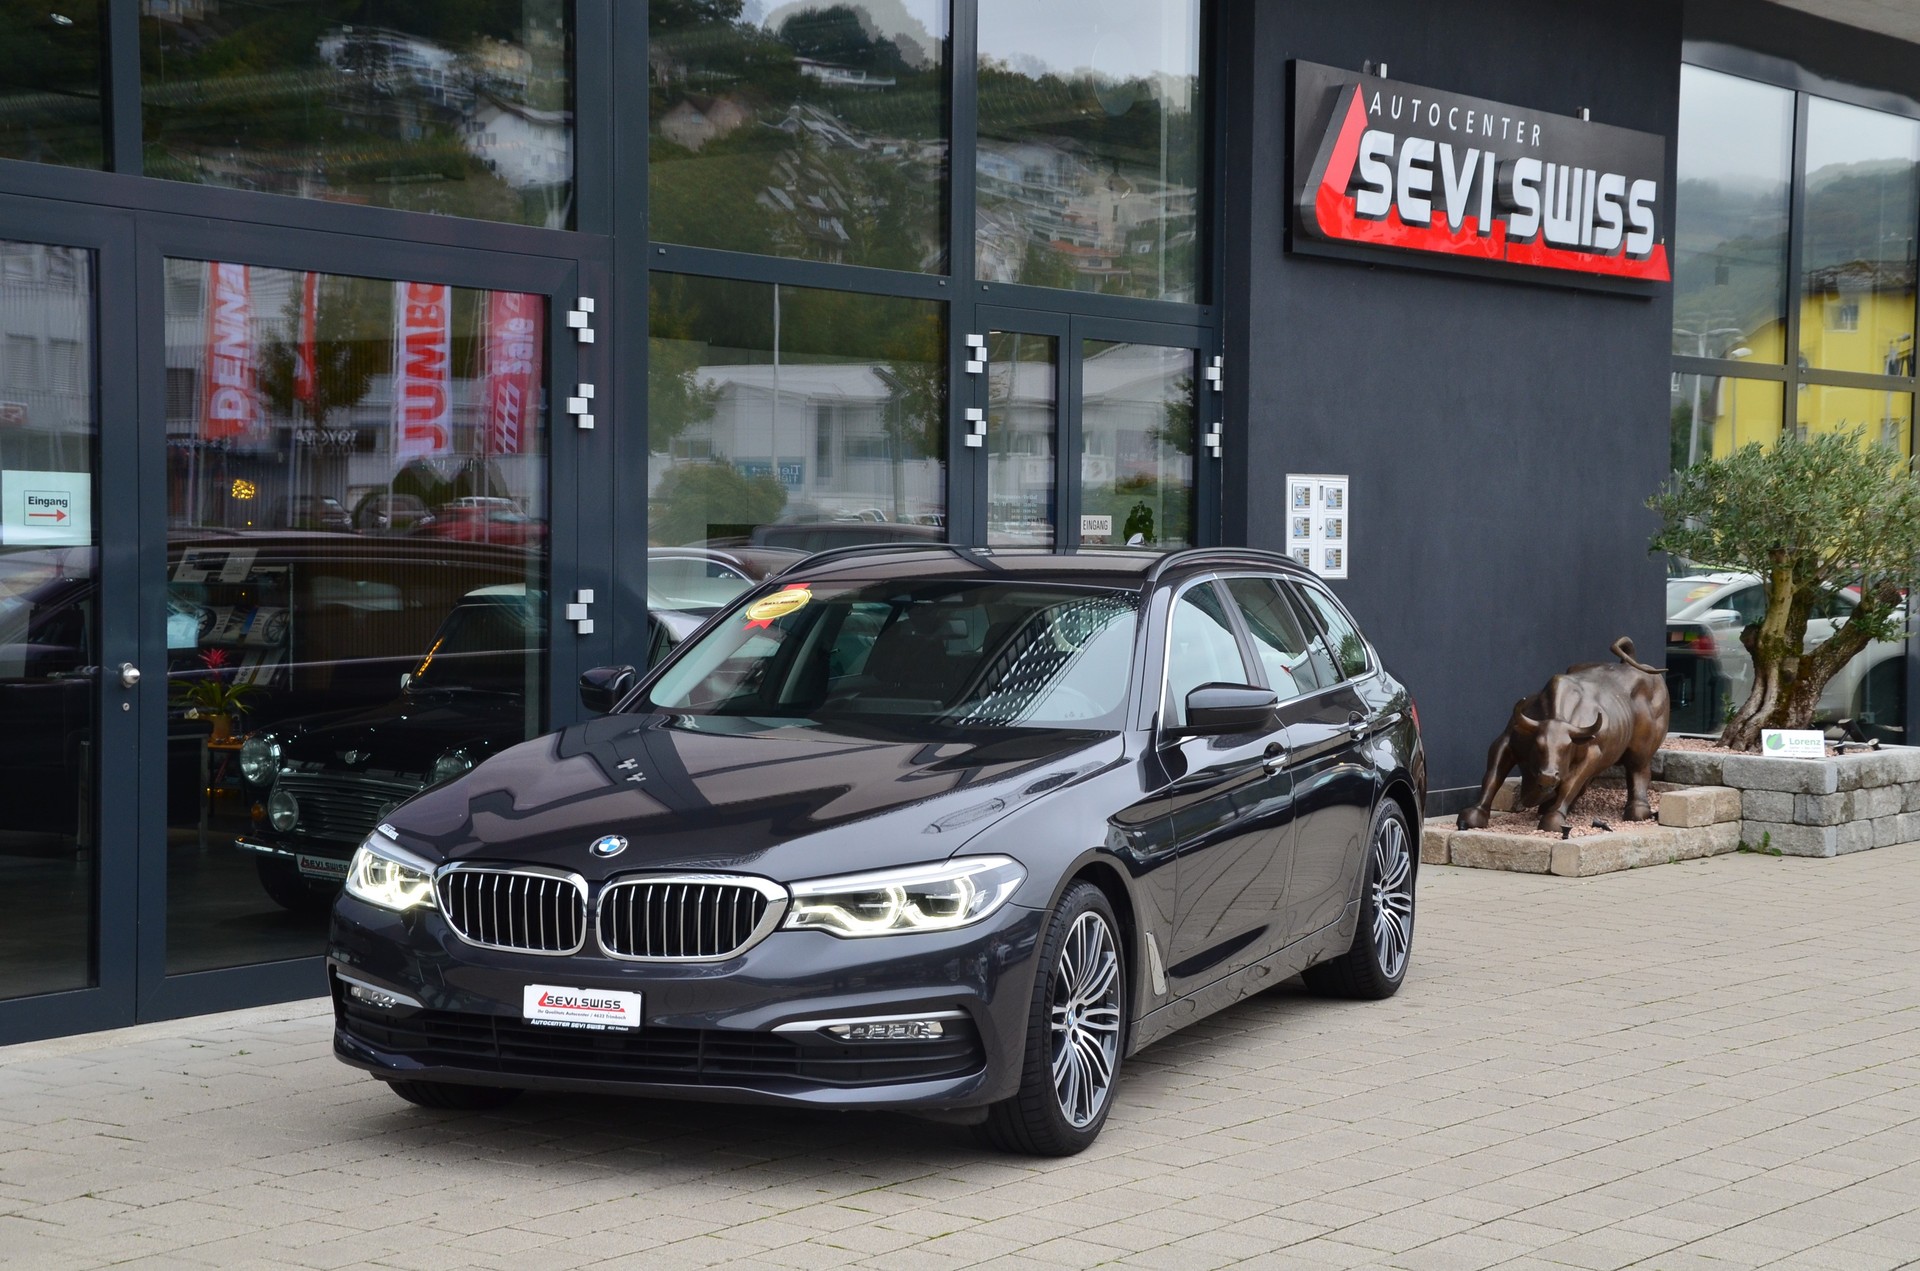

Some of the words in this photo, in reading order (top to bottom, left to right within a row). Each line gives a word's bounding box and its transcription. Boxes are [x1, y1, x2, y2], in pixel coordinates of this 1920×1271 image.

[1369, 91, 1541, 147] AUTOCENTER
[1356, 129, 1496, 233] SEVI
[1509, 156, 1656, 255] SWISS
[494, 317, 534, 375] Sale
[28, 496, 68, 508] Eingang
[1083, 519, 1109, 530] EINGANG
[1789, 738, 1821, 746] Lorenz
[546, 995, 577, 1006] SEVI
[581, 998, 621, 1010] SWISS
